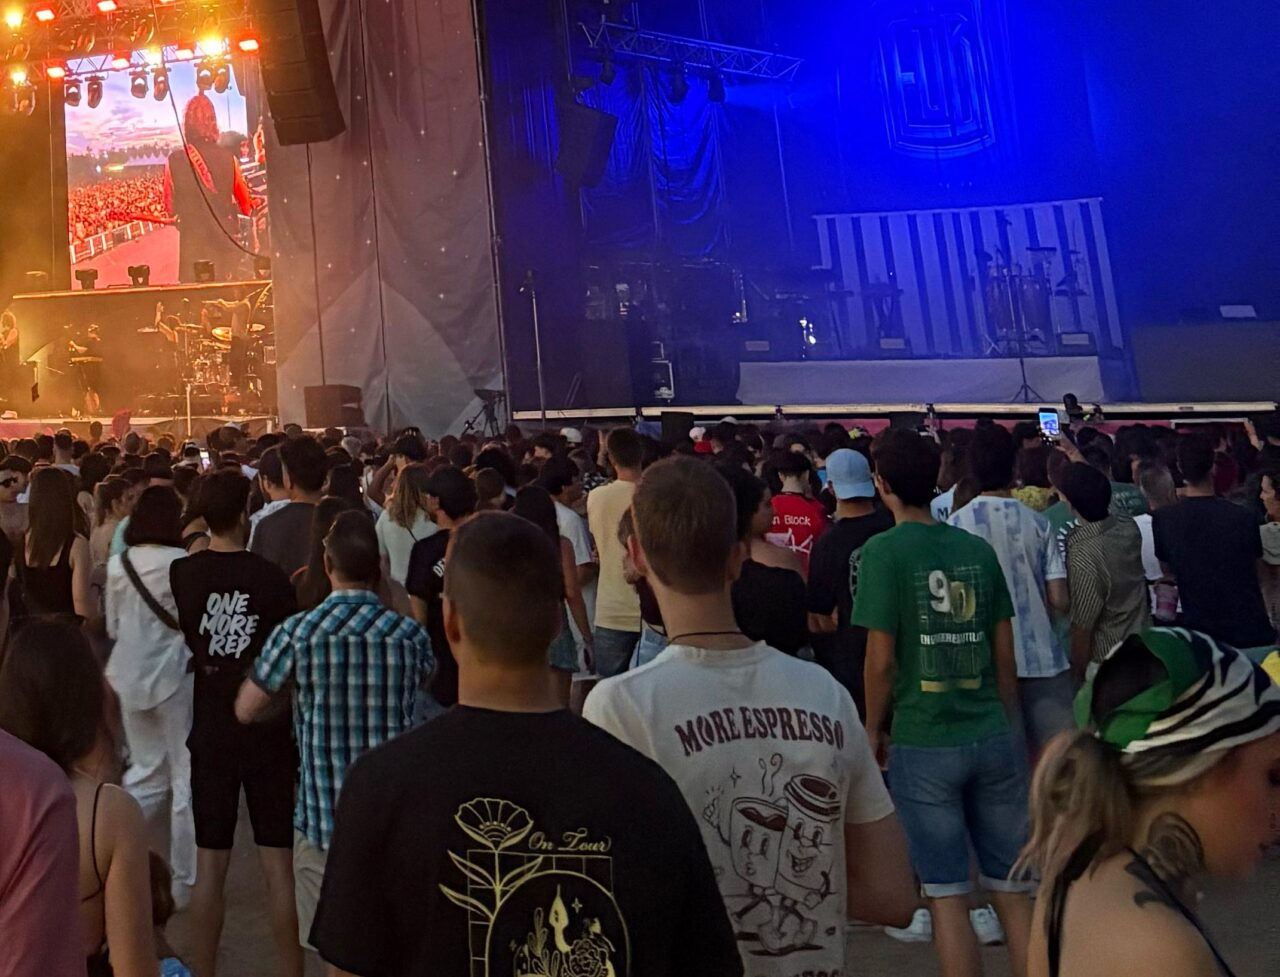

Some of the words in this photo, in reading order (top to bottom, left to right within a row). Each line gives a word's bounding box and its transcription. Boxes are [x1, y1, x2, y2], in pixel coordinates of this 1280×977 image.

[784, 514, 812, 527] Block
[206, 590, 250, 616] ONE
[199, 613, 260, 637] MORE
[208, 634, 251, 659] REP
[674, 708, 741, 757] MORE
[739, 706, 844, 751] ESPRESSO
[528, 831, 554, 851] On
[557, 827, 612, 852] Tour
